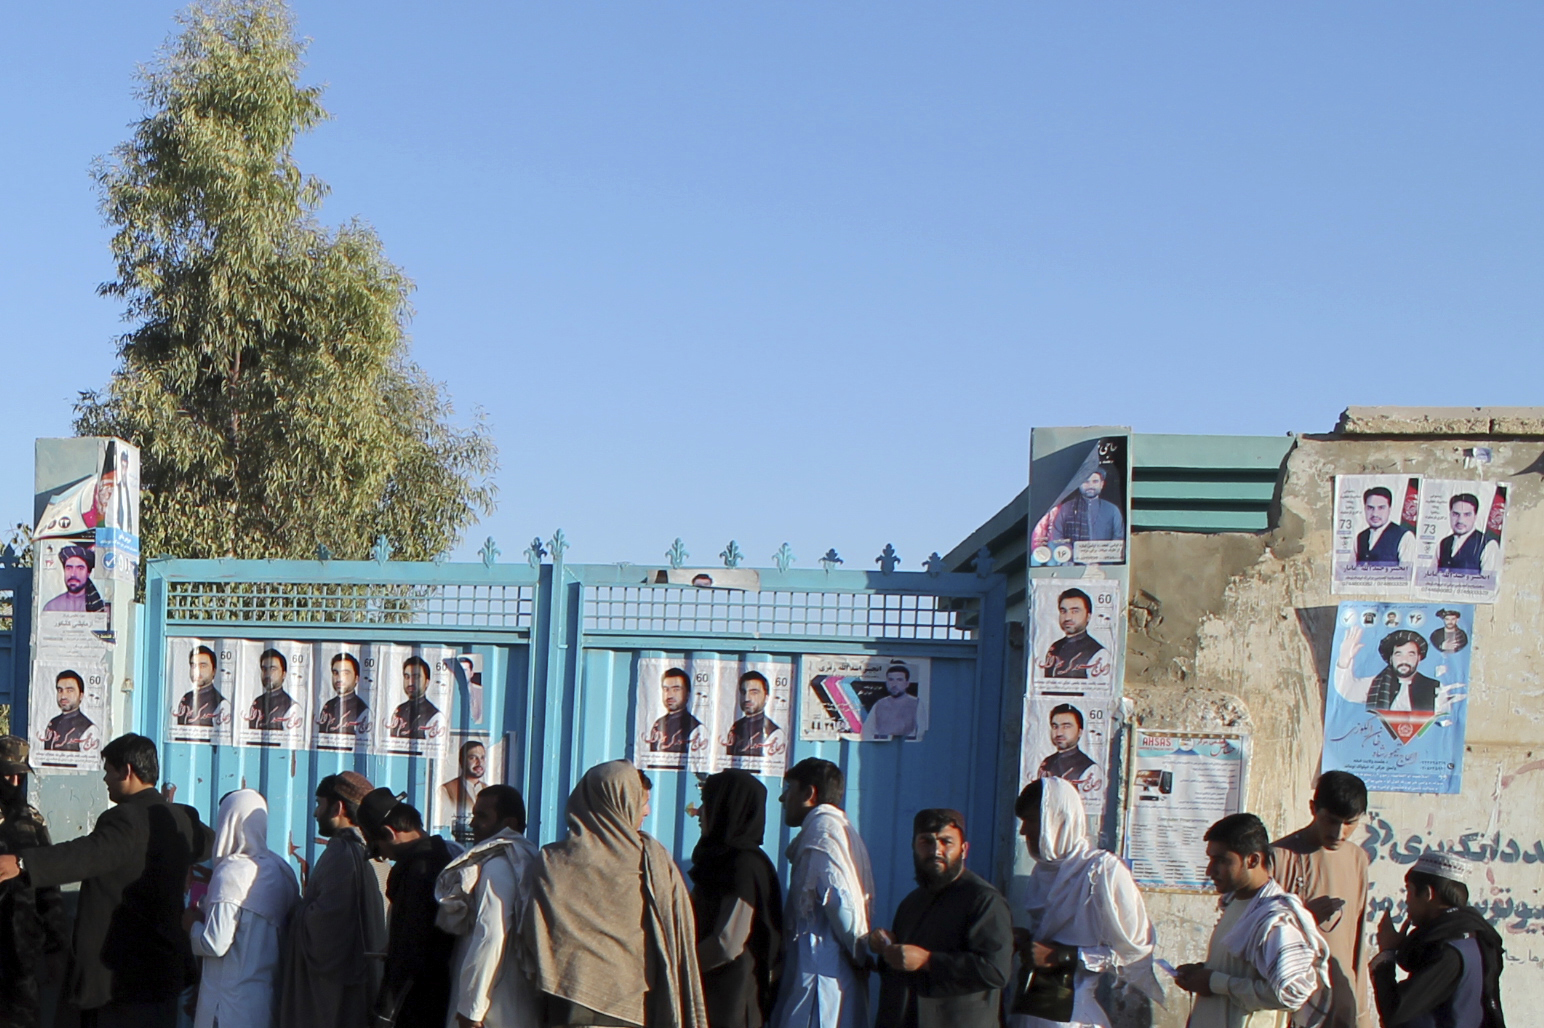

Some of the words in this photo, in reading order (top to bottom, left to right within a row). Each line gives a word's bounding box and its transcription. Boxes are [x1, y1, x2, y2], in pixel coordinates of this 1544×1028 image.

[1339, 519, 1352, 530] 73
[1423, 524, 1437, 535] 73
[1097, 593, 1112, 605] 60
[1409, 614, 1423, 624] ۲۶
[220, 650, 232, 661] 60
[292, 654, 304, 664] 60
[363, 657, 375, 668] 60
[435, 661, 448, 672] 60
[89, 675, 102, 685] 60
[695, 672, 709, 683] 60
[774, 676, 788, 688] 60
[1089, 709, 1104, 720] 60
[1142, 737, 1172, 747] AHSAS
